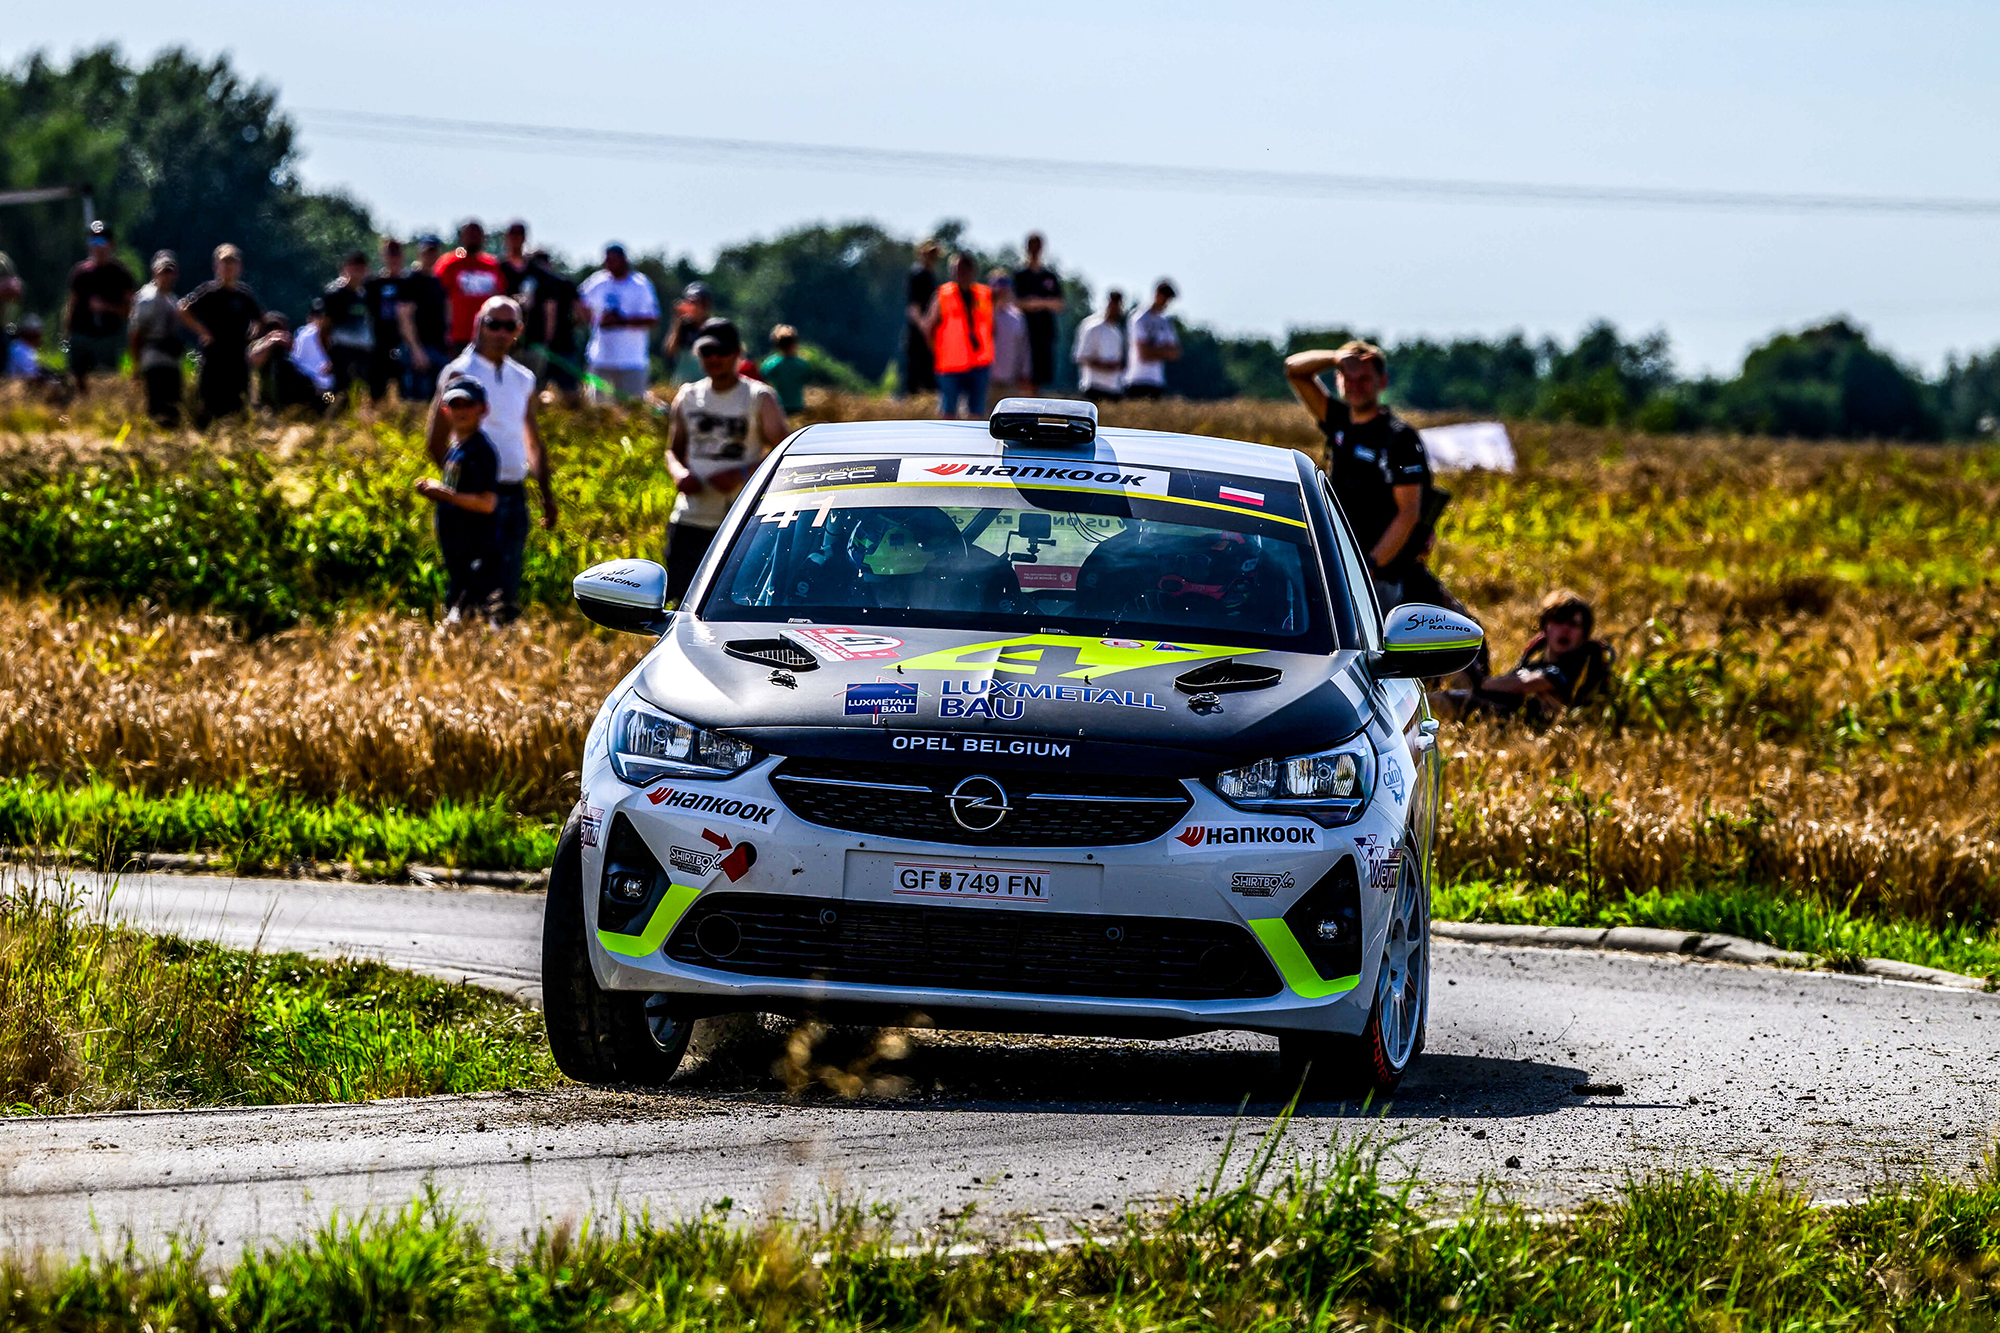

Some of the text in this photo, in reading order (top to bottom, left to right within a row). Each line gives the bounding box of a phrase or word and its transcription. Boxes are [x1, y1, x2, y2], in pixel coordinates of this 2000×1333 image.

[760, 495, 836, 529] 41
[600, 576, 642, 588] RACING
[1405, 614, 1446, 631] Stohl
[848, 698, 915, 708] LUXMETALL
[940, 679, 1166, 711] LUXMETALL
[881, 705, 907, 714] BAU
[938, 697, 1025, 720] BAU
[892, 736, 1071, 757] OPEL BELGIUM
[900, 869, 1042, 897] GF 749 FN
